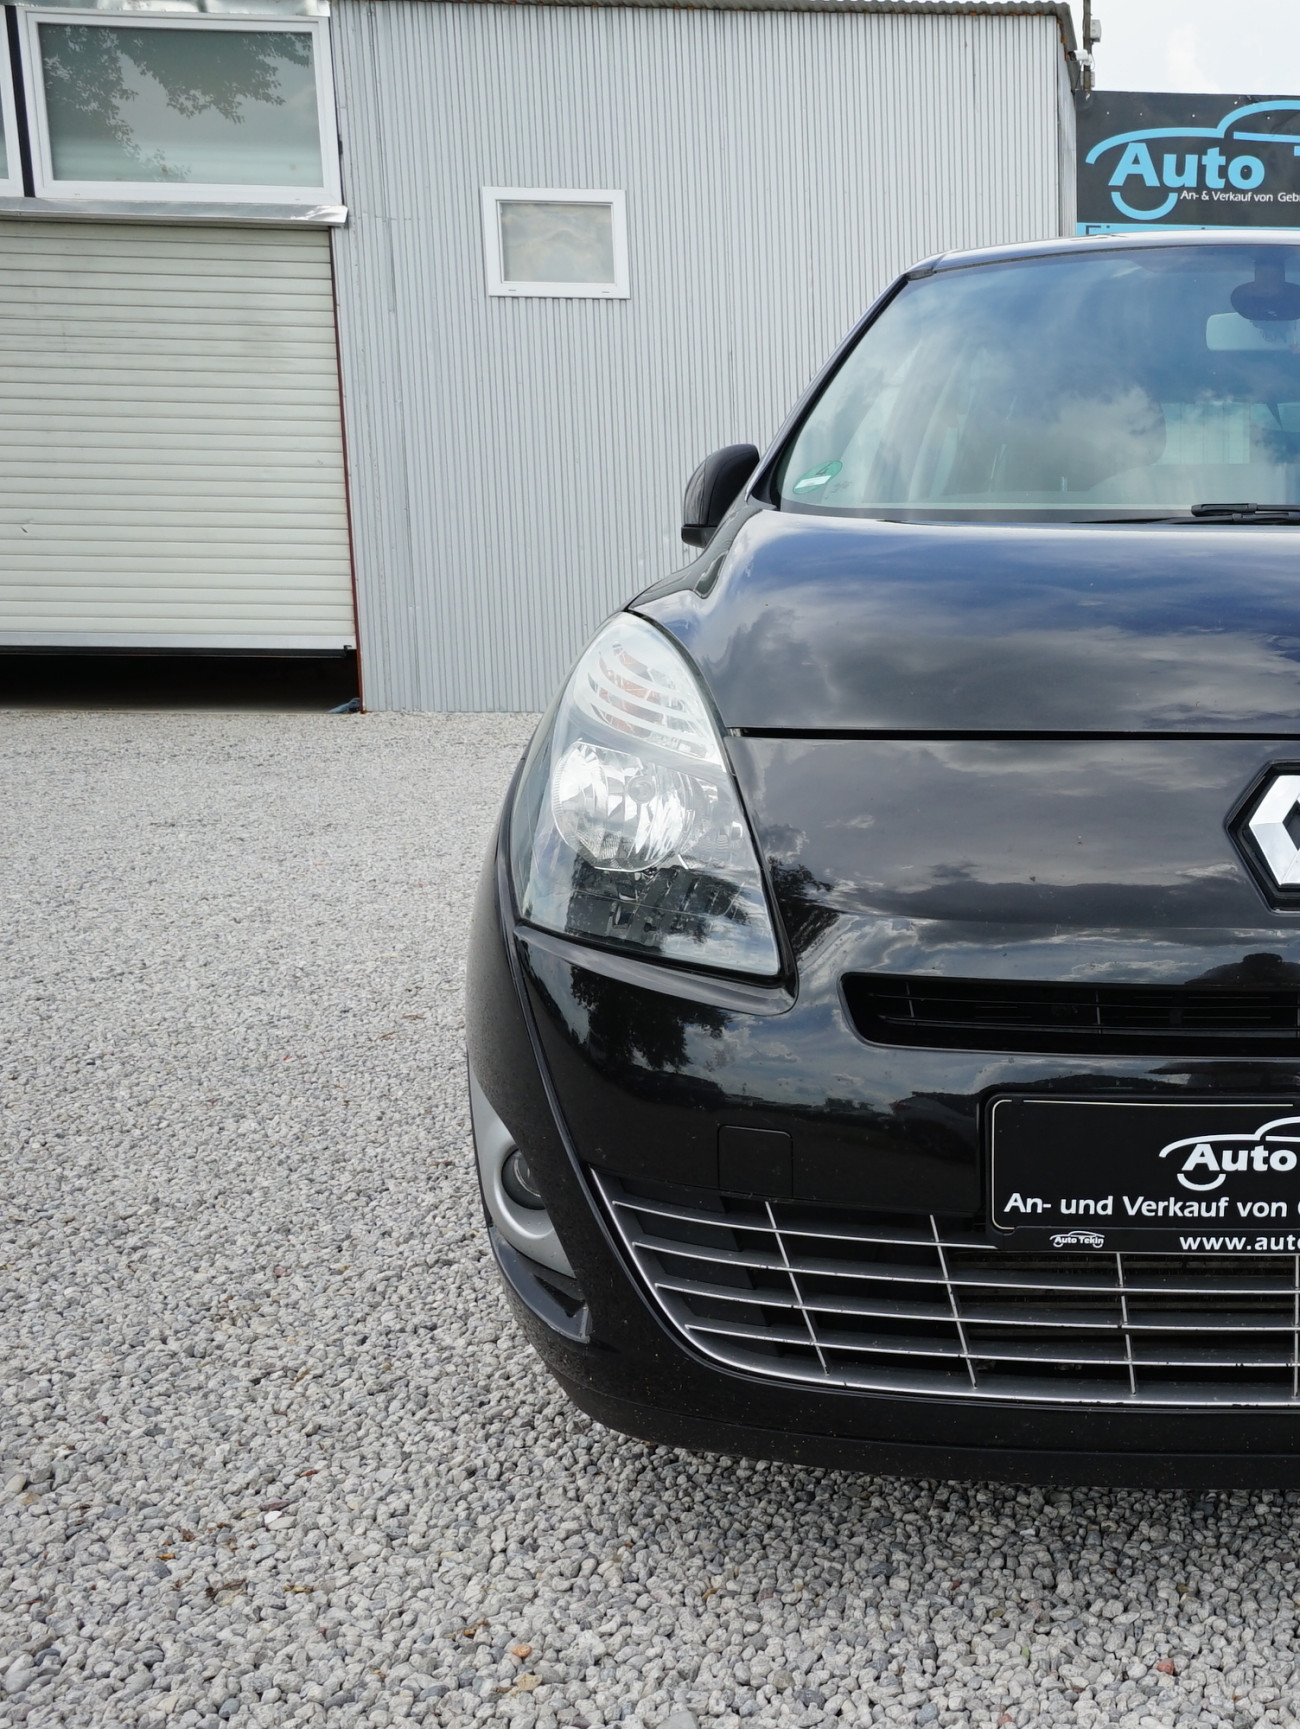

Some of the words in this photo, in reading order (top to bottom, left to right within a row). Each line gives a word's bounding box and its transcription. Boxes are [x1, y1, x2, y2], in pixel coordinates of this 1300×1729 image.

[1108, 142, 1266, 189] Auto
[1201, 190, 1210, 200] &
[1211, 191, 1253, 202] Verkauf
[1253, 194, 1273, 202] von
[1181, 1143, 1298, 1172] Auto
[1003, 1192, 1052, 1213] An-
[1059, 1195, 1114, 1215] und
[1122, 1195, 1230, 1218] Verkauf
[1236, 1200, 1288, 1218] von
[1054, 1235, 1077, 1244] Auto
[1078, 1235, 1104, 1245] Tekin
